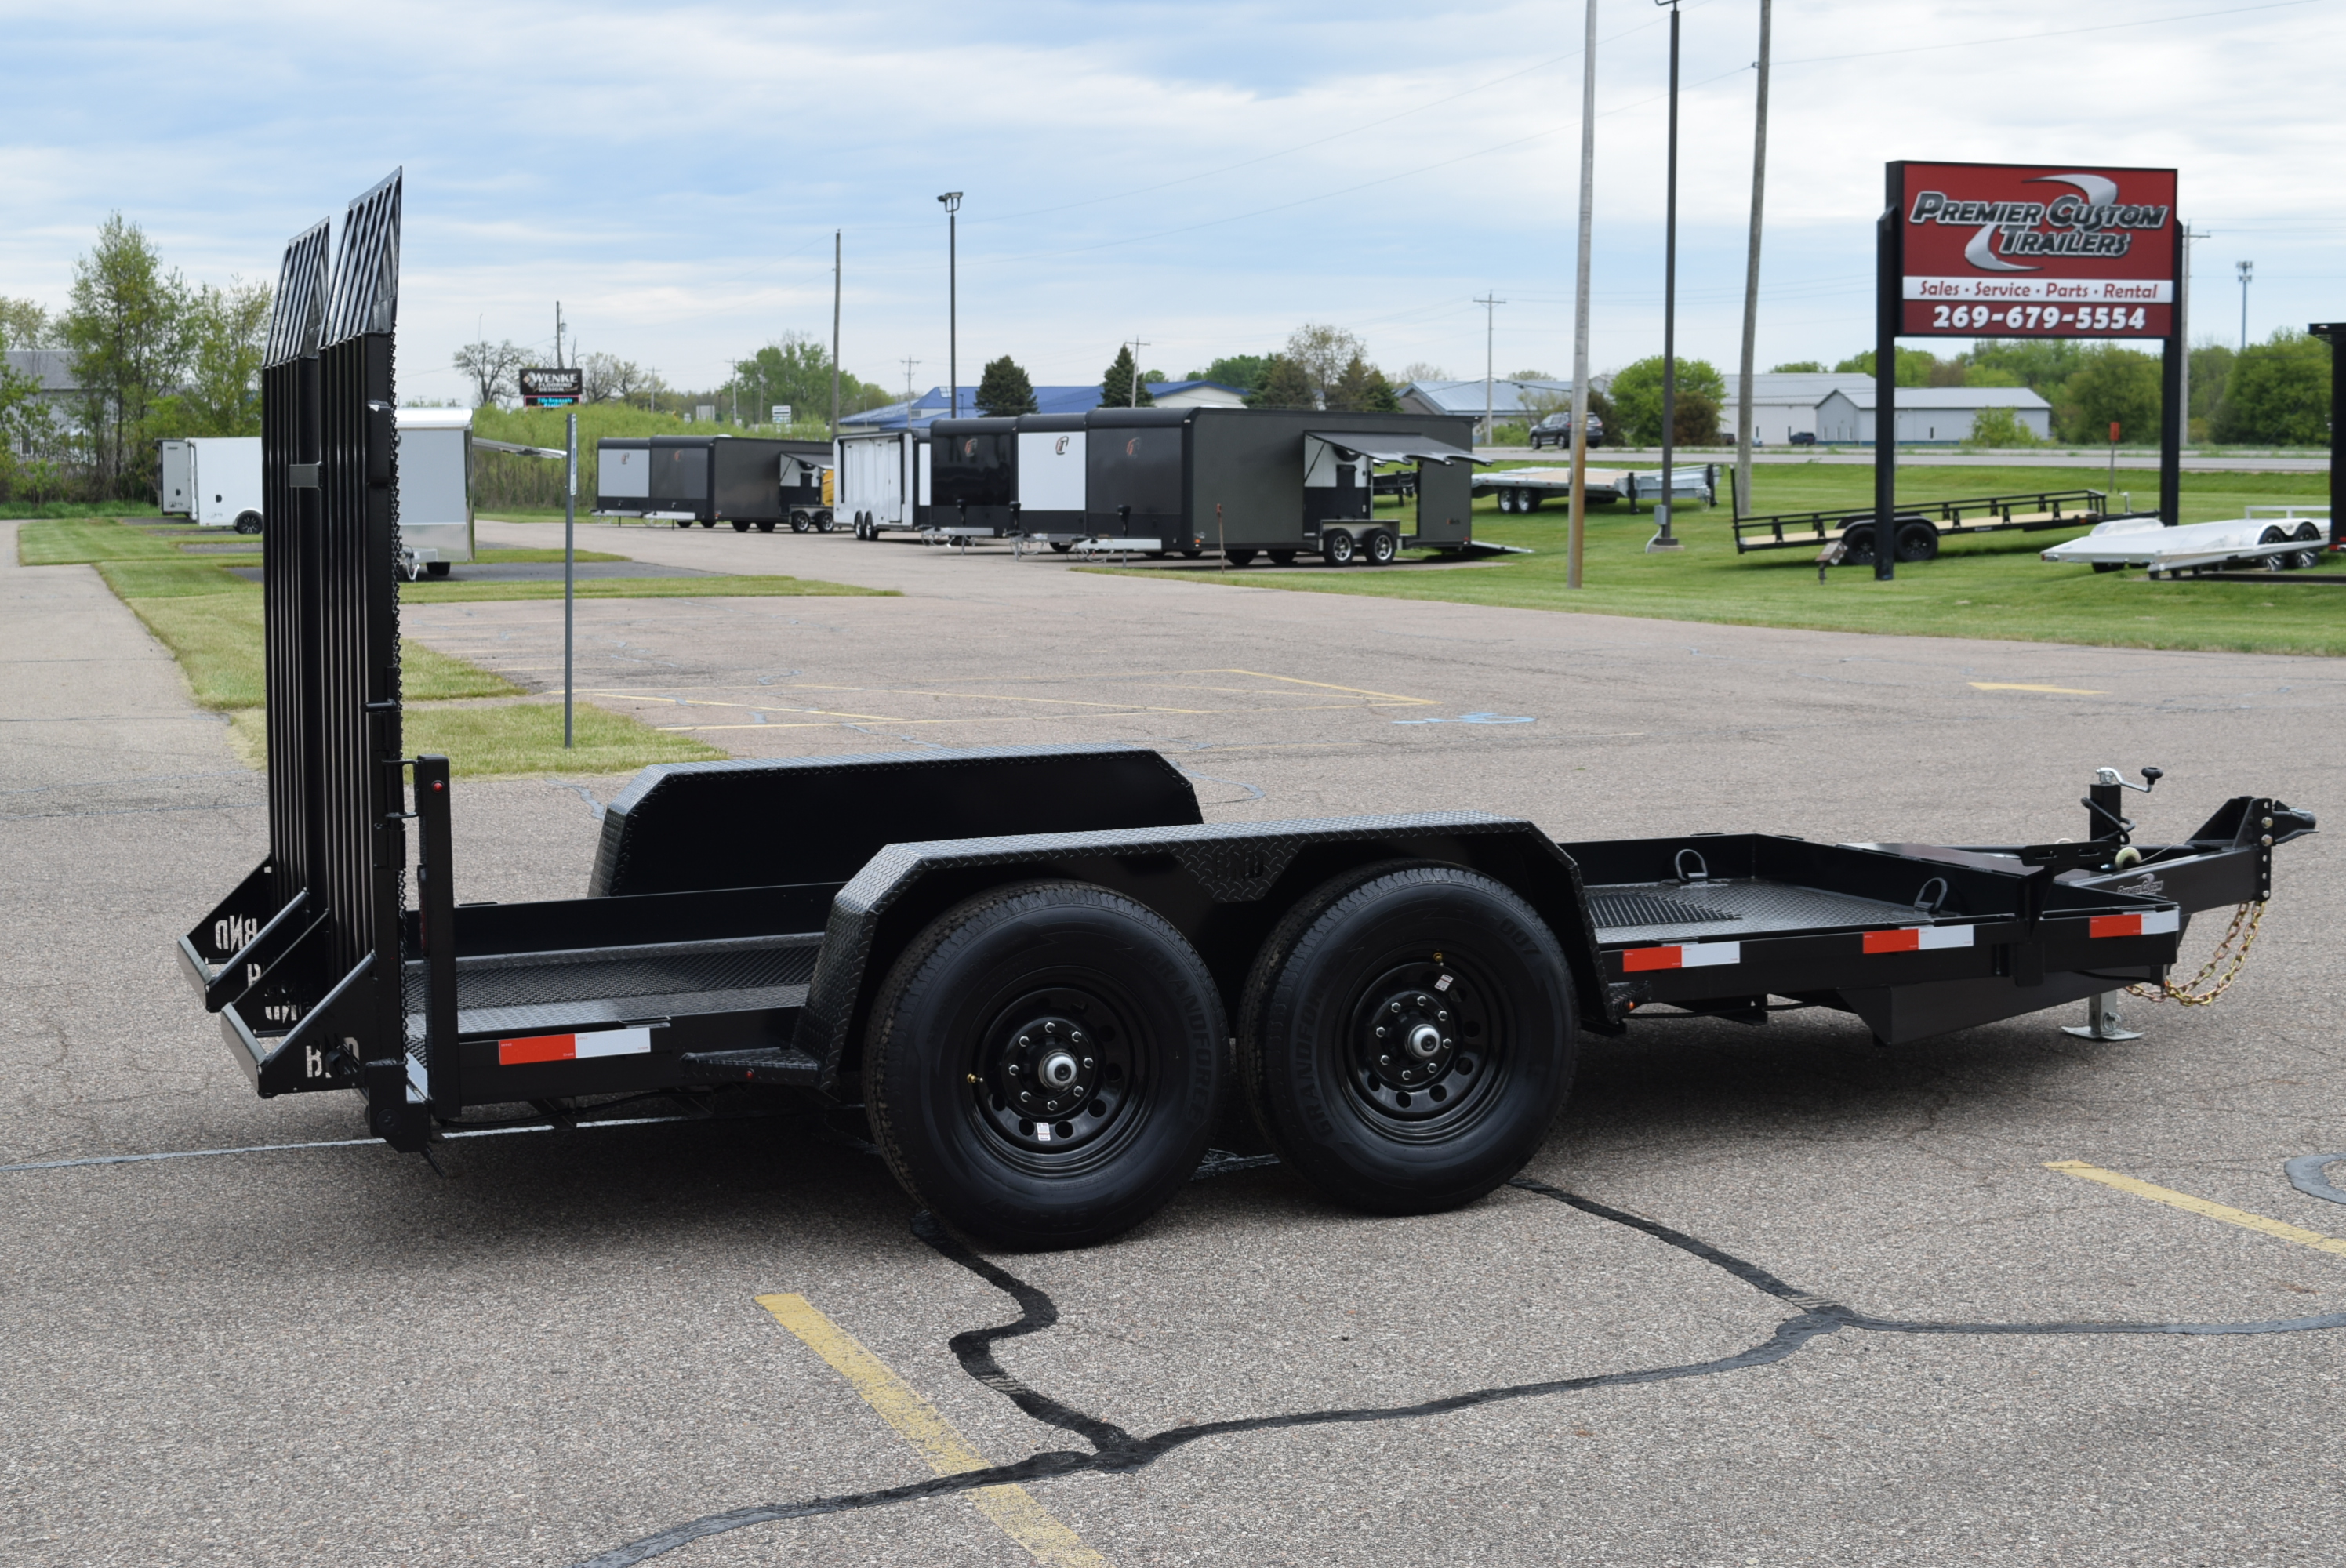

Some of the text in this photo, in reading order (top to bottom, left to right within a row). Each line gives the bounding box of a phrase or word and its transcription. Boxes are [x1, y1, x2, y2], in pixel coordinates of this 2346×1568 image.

[1919, 280, 2158, 299] Sales Service Parts Rental
[1933, 305, 2146, 330] 269-679-5554
[532, 372, 578, 383] WENKE
